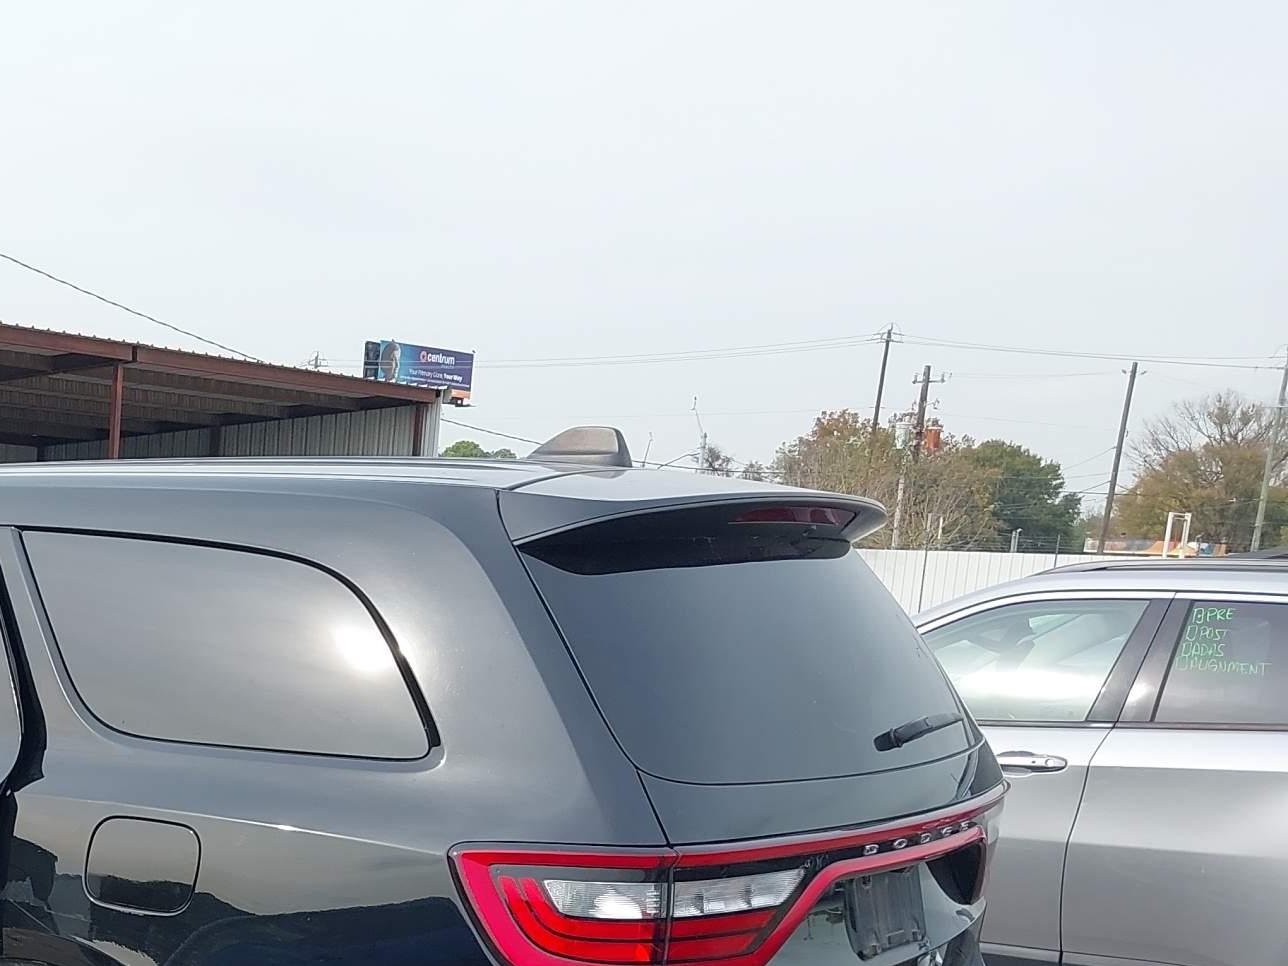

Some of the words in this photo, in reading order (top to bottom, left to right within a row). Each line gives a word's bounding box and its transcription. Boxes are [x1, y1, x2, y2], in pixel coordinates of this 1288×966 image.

[427, 353, 455, 365] centrum
[1207, 608, 1237, 621] PRE
[1200, 626, 1232, 641] POST
[863, 820, 970, 856] DODGE
